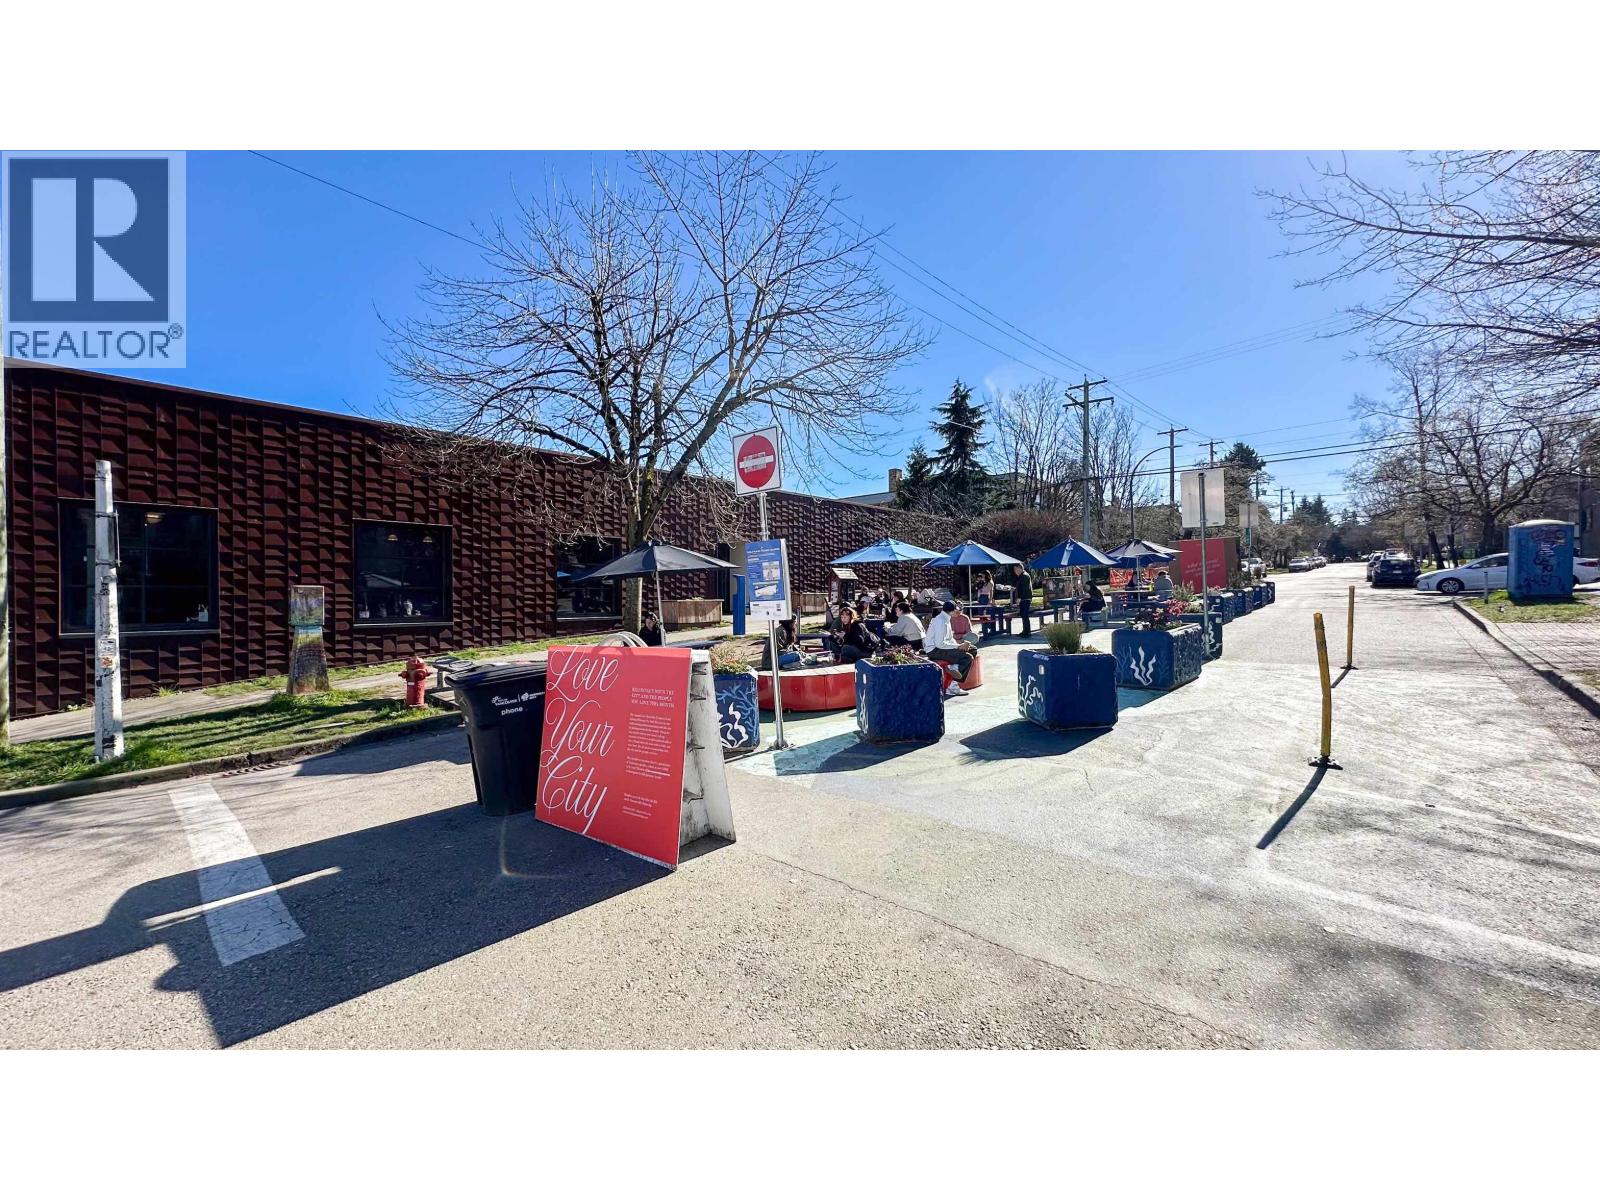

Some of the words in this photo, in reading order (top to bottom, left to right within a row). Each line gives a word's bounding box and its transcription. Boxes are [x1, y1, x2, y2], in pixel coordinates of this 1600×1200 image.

[546, 646, 618, 701] Love
[501, 706, 523, 716] phone
[540, 697, 614, 767] Your
[543, 755, 607, 835] City
